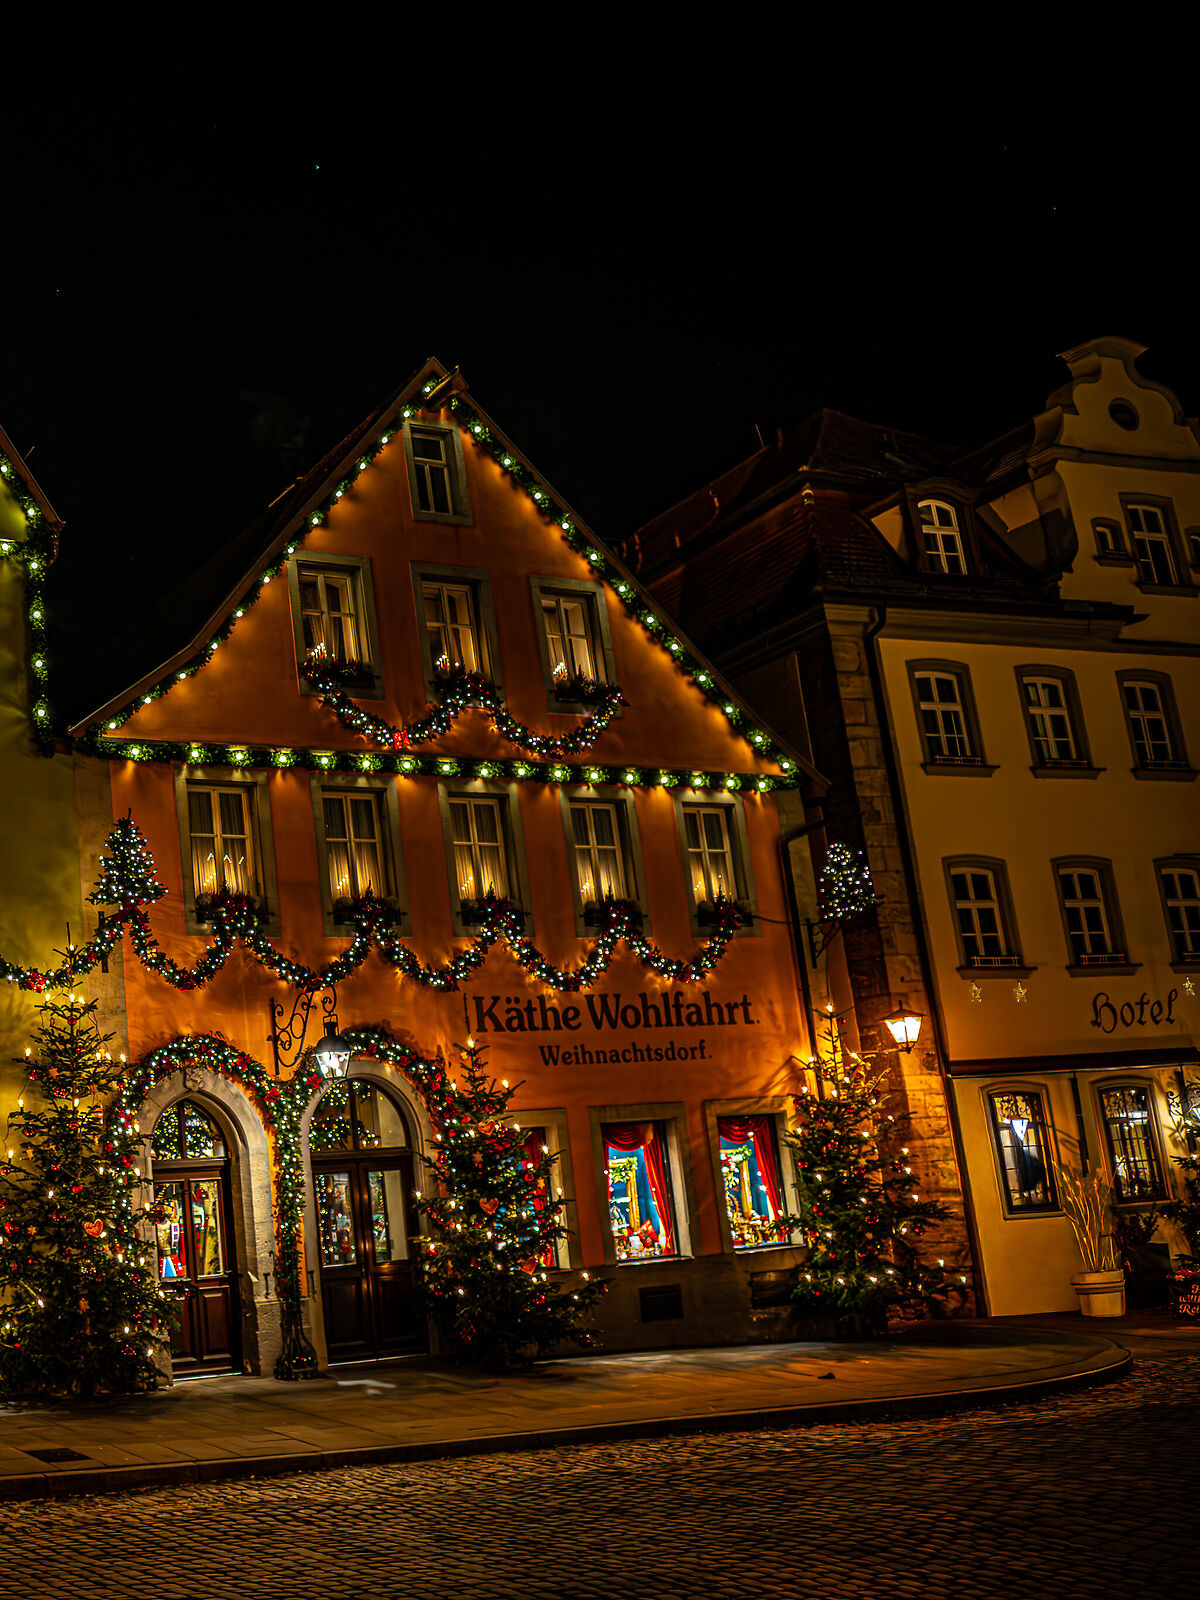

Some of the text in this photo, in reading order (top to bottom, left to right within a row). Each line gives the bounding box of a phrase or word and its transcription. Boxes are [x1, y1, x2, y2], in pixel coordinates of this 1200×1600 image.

[472, 990, 761, 1033] Käthe Wohlfahrt.
[1090, 987, 1178, 1034] Hotel
[538, 1038, 713, 1067] Weihnachtsdorf.
